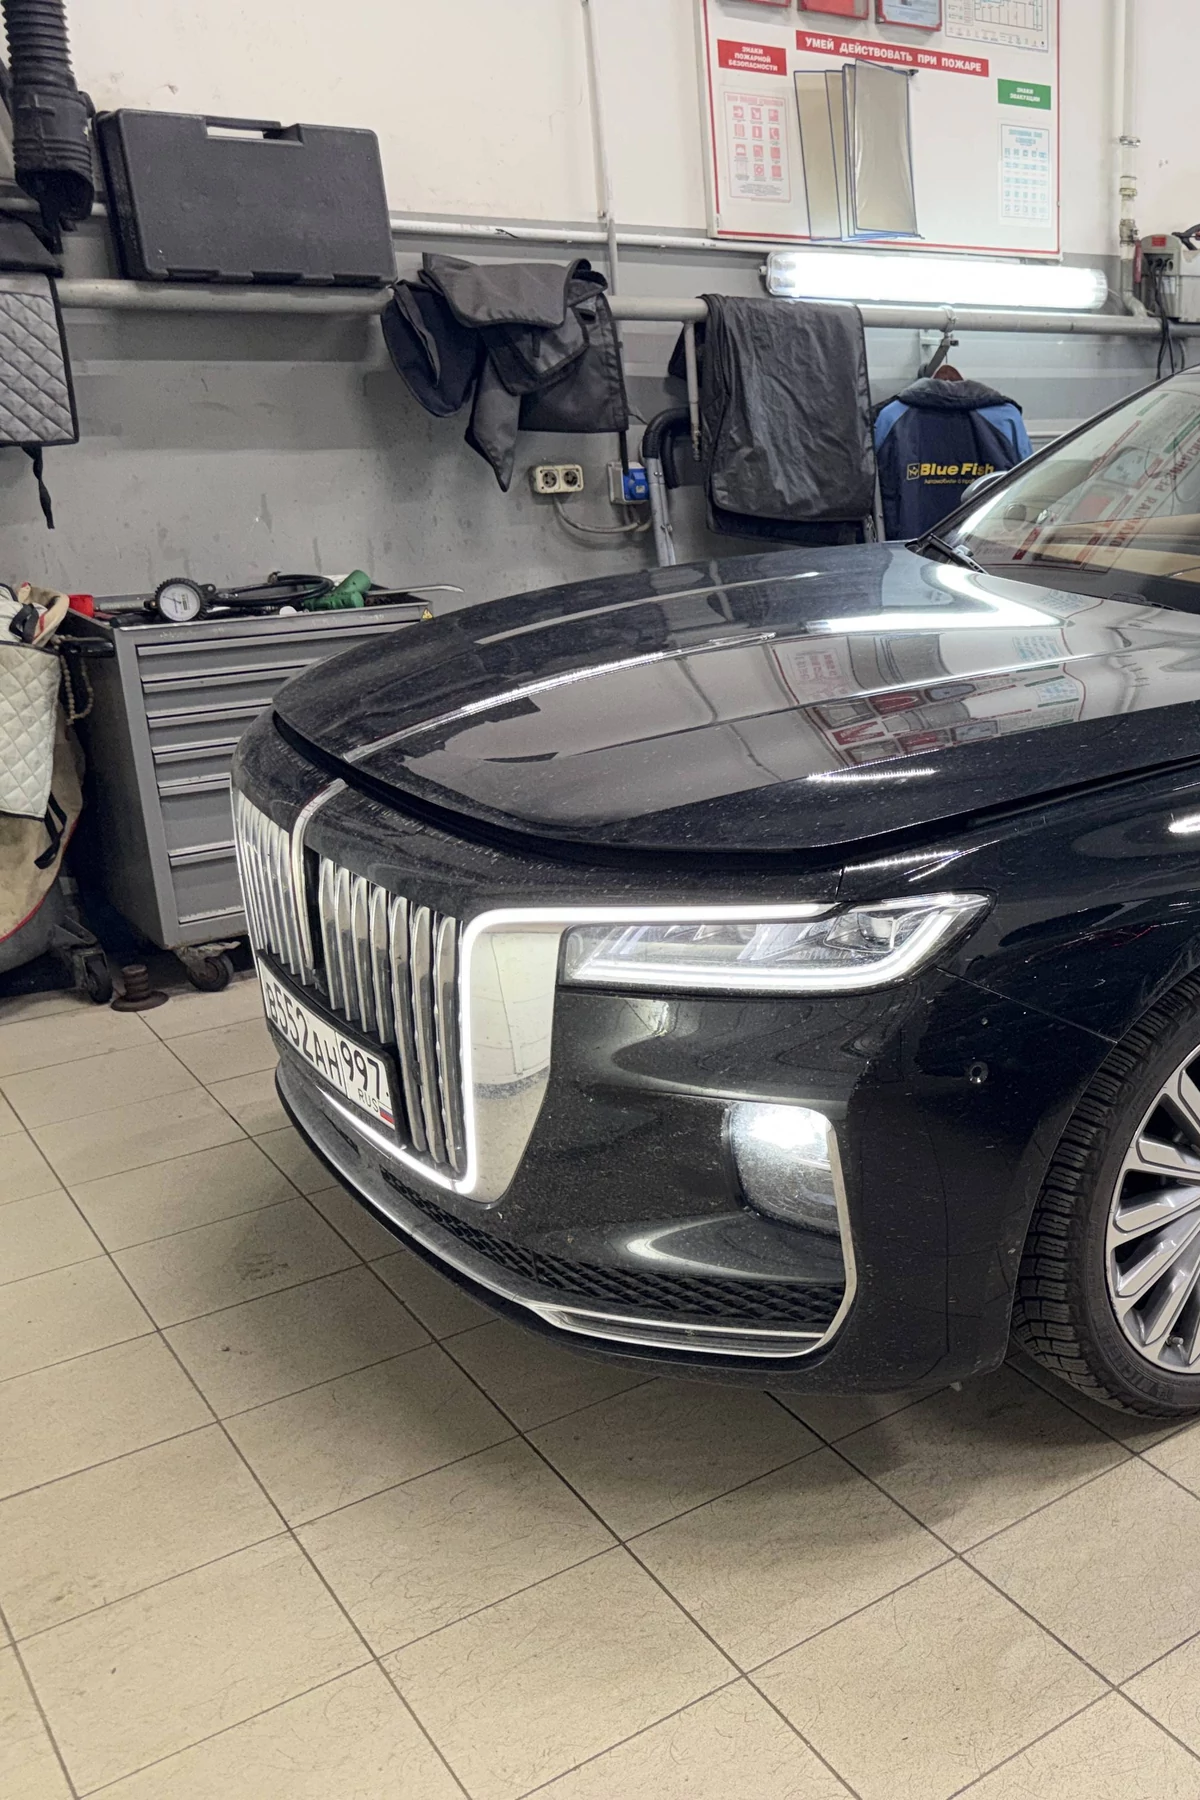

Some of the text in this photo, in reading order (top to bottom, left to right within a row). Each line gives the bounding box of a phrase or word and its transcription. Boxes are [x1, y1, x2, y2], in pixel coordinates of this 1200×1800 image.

[742, 46, 763, 55] ЗНАКИ
[805, 37, 982, 72] УМЕЙ ДЕЙСТВОВАТЬ ПРИ ПОЖАРЕ
[734, 52, 771, 63] ПОЖАРНОЙ
[728, 59, 778, 71] БЕЗОПАСНОСТИ
[920, 463, 995, 476] Blue Fish
[357, 1088, 379, 1113] RUS
